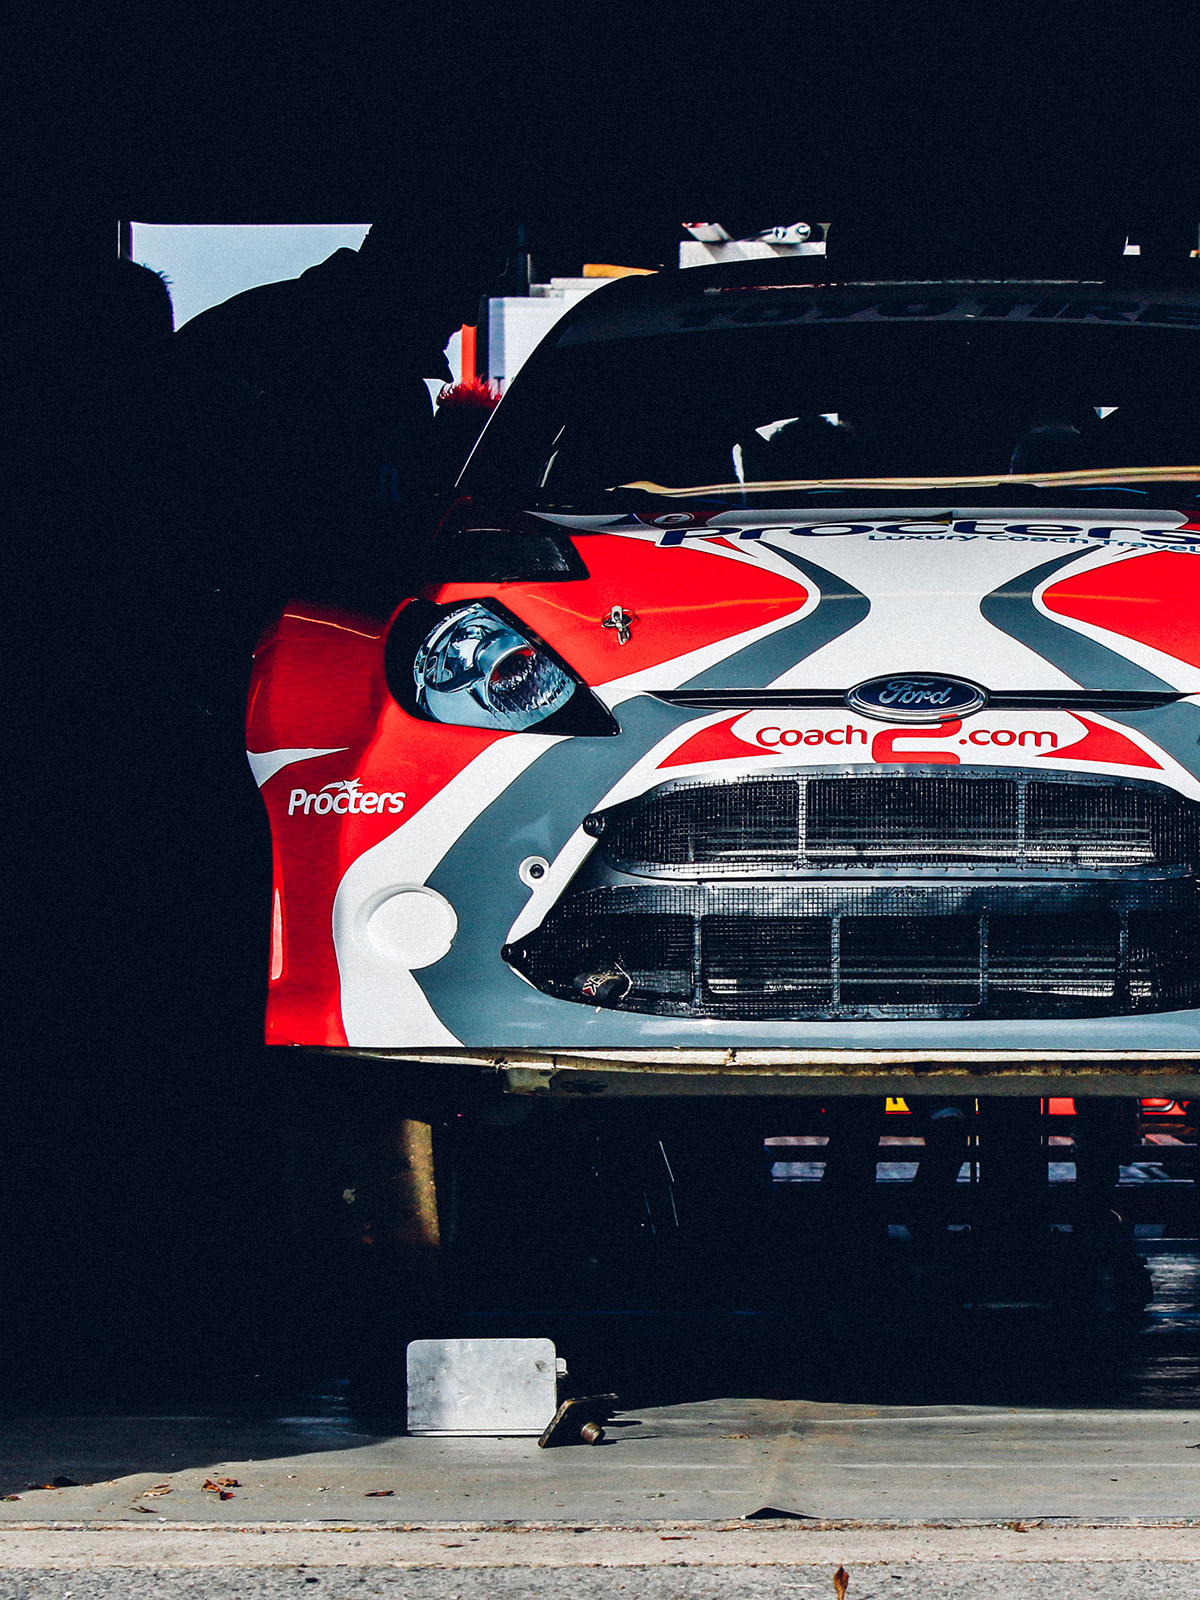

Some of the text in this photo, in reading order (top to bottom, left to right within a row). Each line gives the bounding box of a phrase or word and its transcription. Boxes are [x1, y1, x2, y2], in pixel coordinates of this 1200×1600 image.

[679, 298, 957, 328] TOYO
[986, 535, 1089, 544] Coach
[878, 680, 953, 705] Ford
[287, 788, 407, 817] Procters
